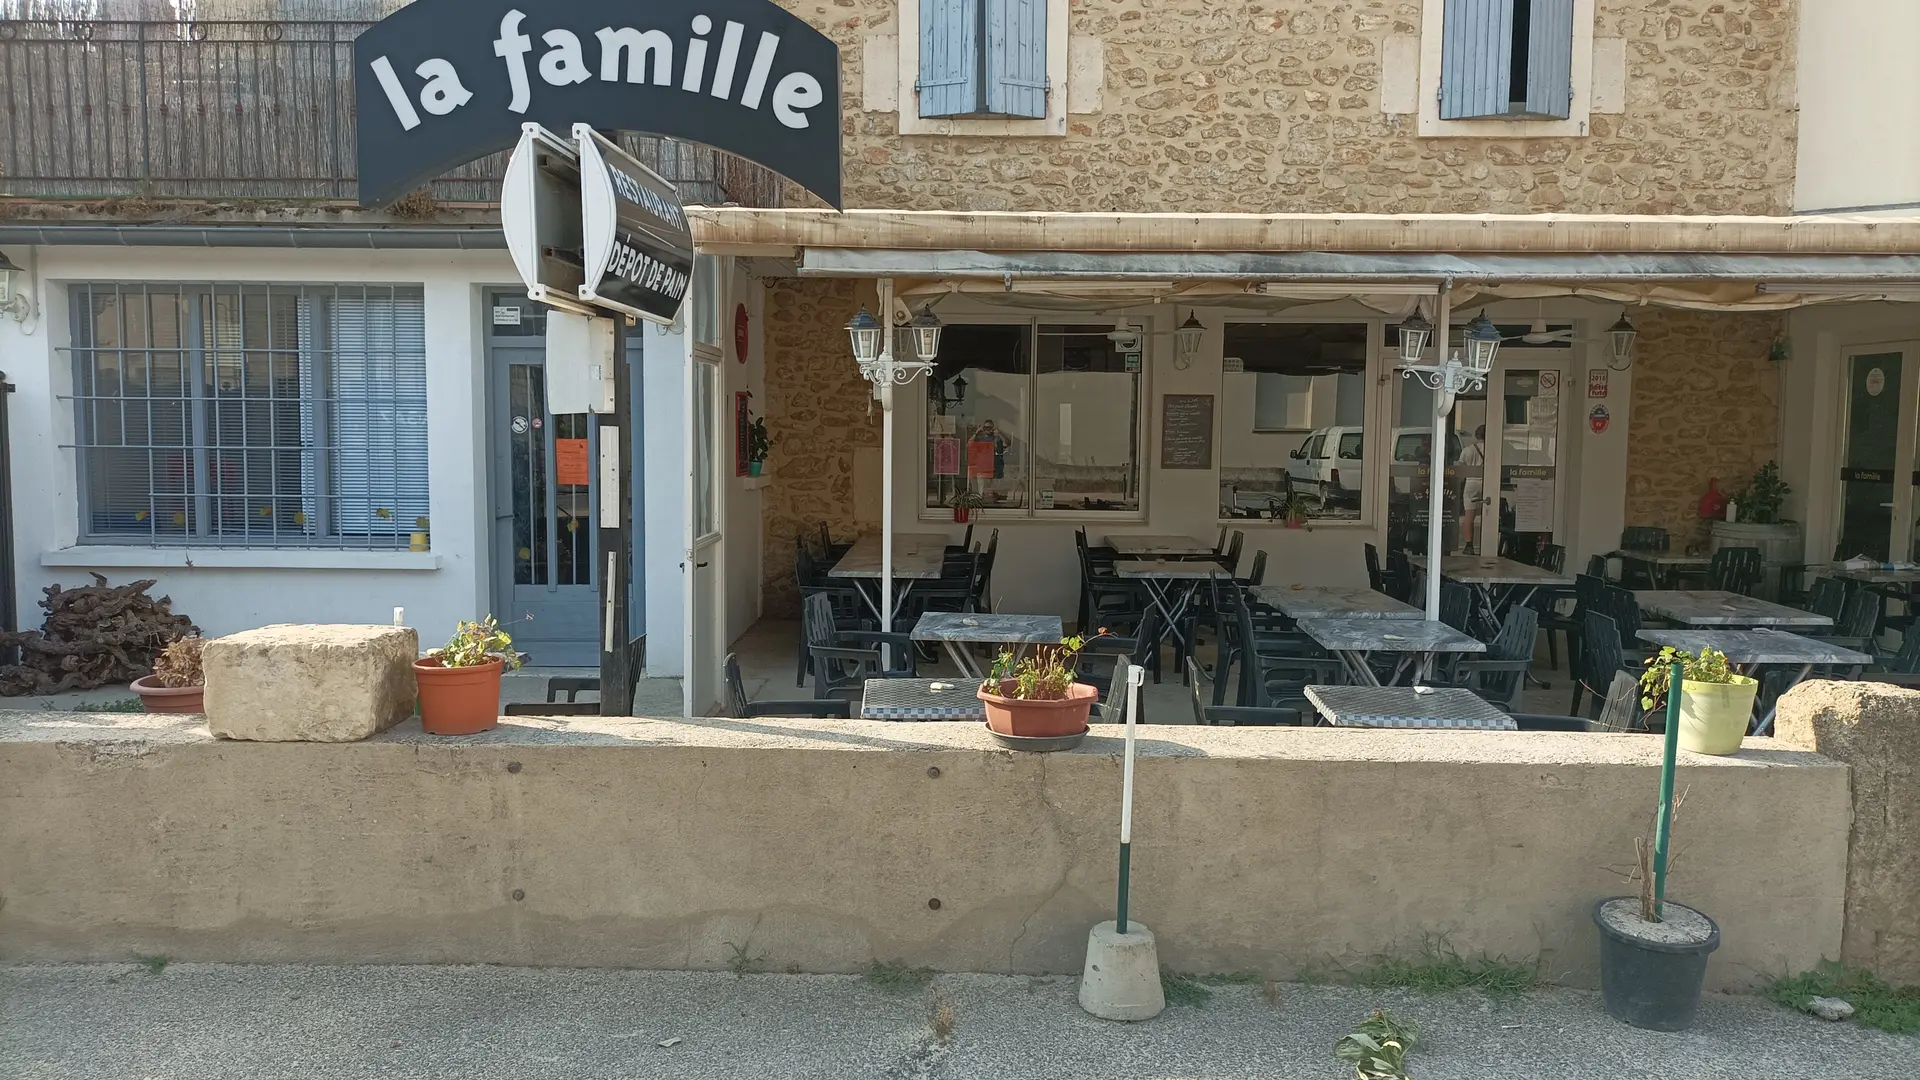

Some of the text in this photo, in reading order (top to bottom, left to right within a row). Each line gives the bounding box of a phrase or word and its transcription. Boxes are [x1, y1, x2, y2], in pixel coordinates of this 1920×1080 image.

[370, 8, 824, 131] la famille
[609, 163, 684, 232] RESTAURANT
[606, 233, 688, 300] DÉPOT DE PAIN
[1509, 468, 1547, 476] la famille
[1860, 471, 1880, 481] famille
